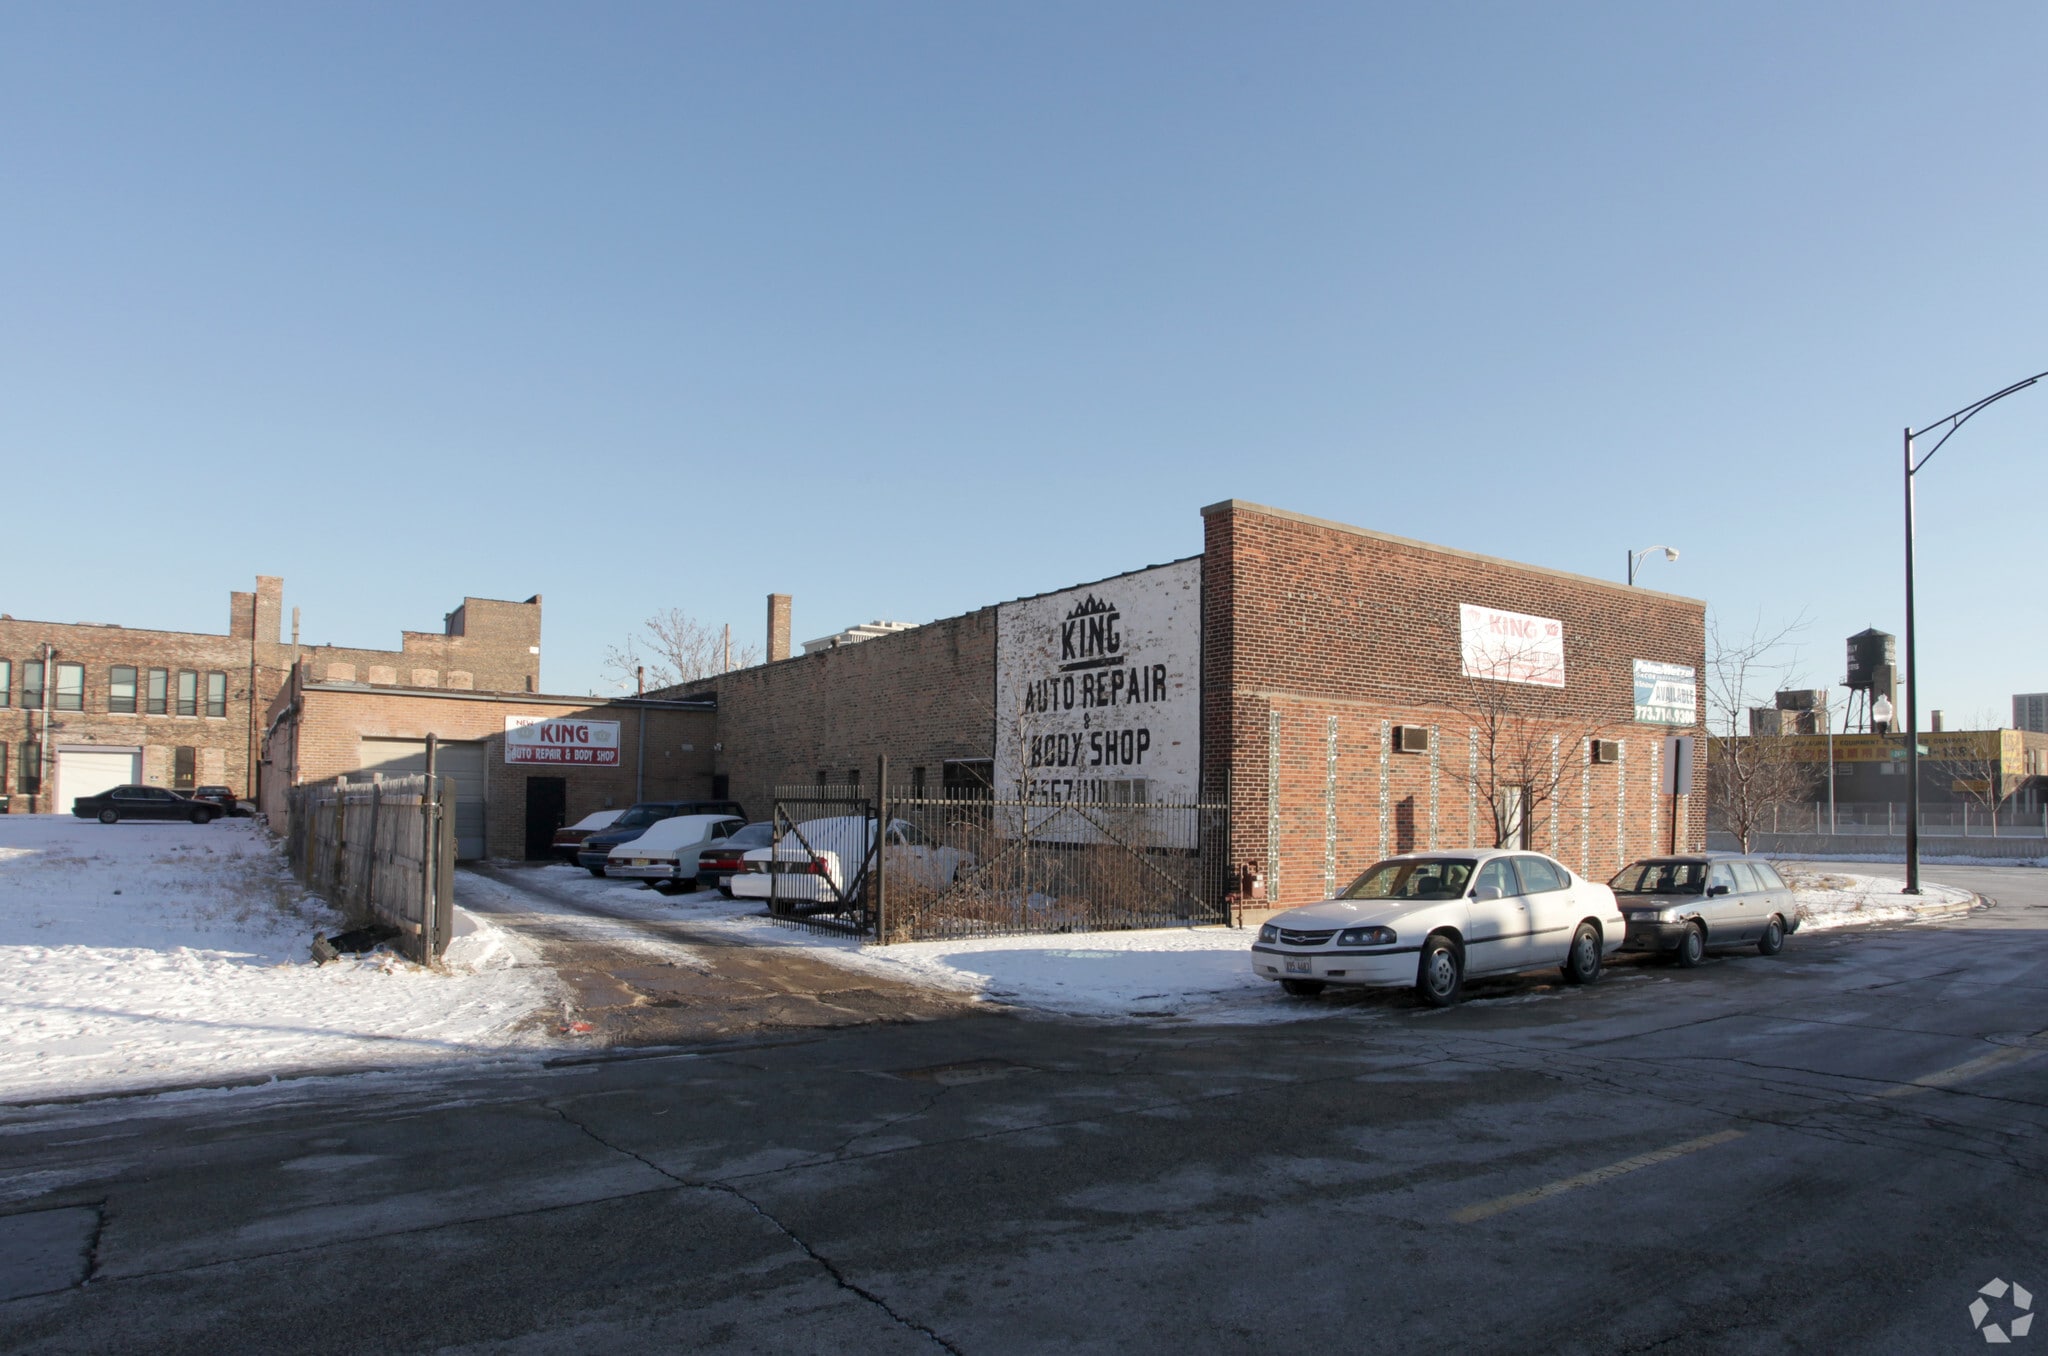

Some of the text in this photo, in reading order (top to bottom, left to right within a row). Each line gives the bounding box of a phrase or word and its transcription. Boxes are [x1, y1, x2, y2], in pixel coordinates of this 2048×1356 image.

[1062, 612, 1120, 661] KING
[1488, 613, 1538, 640] KING
[1025, 663, 1167, 713] AUTO REPAIR
[1655, 686, 1694, 704] AVAILABLE
[516, 719, 534, 727] NEW
[1083, 712, 1091, 729] &
[540, 724, 589, 744] KING
[511, 748, 615, 762] AUTO REPAIR & BODY SHOP
[1031, 728, 1151, 767] BODY SHOP
